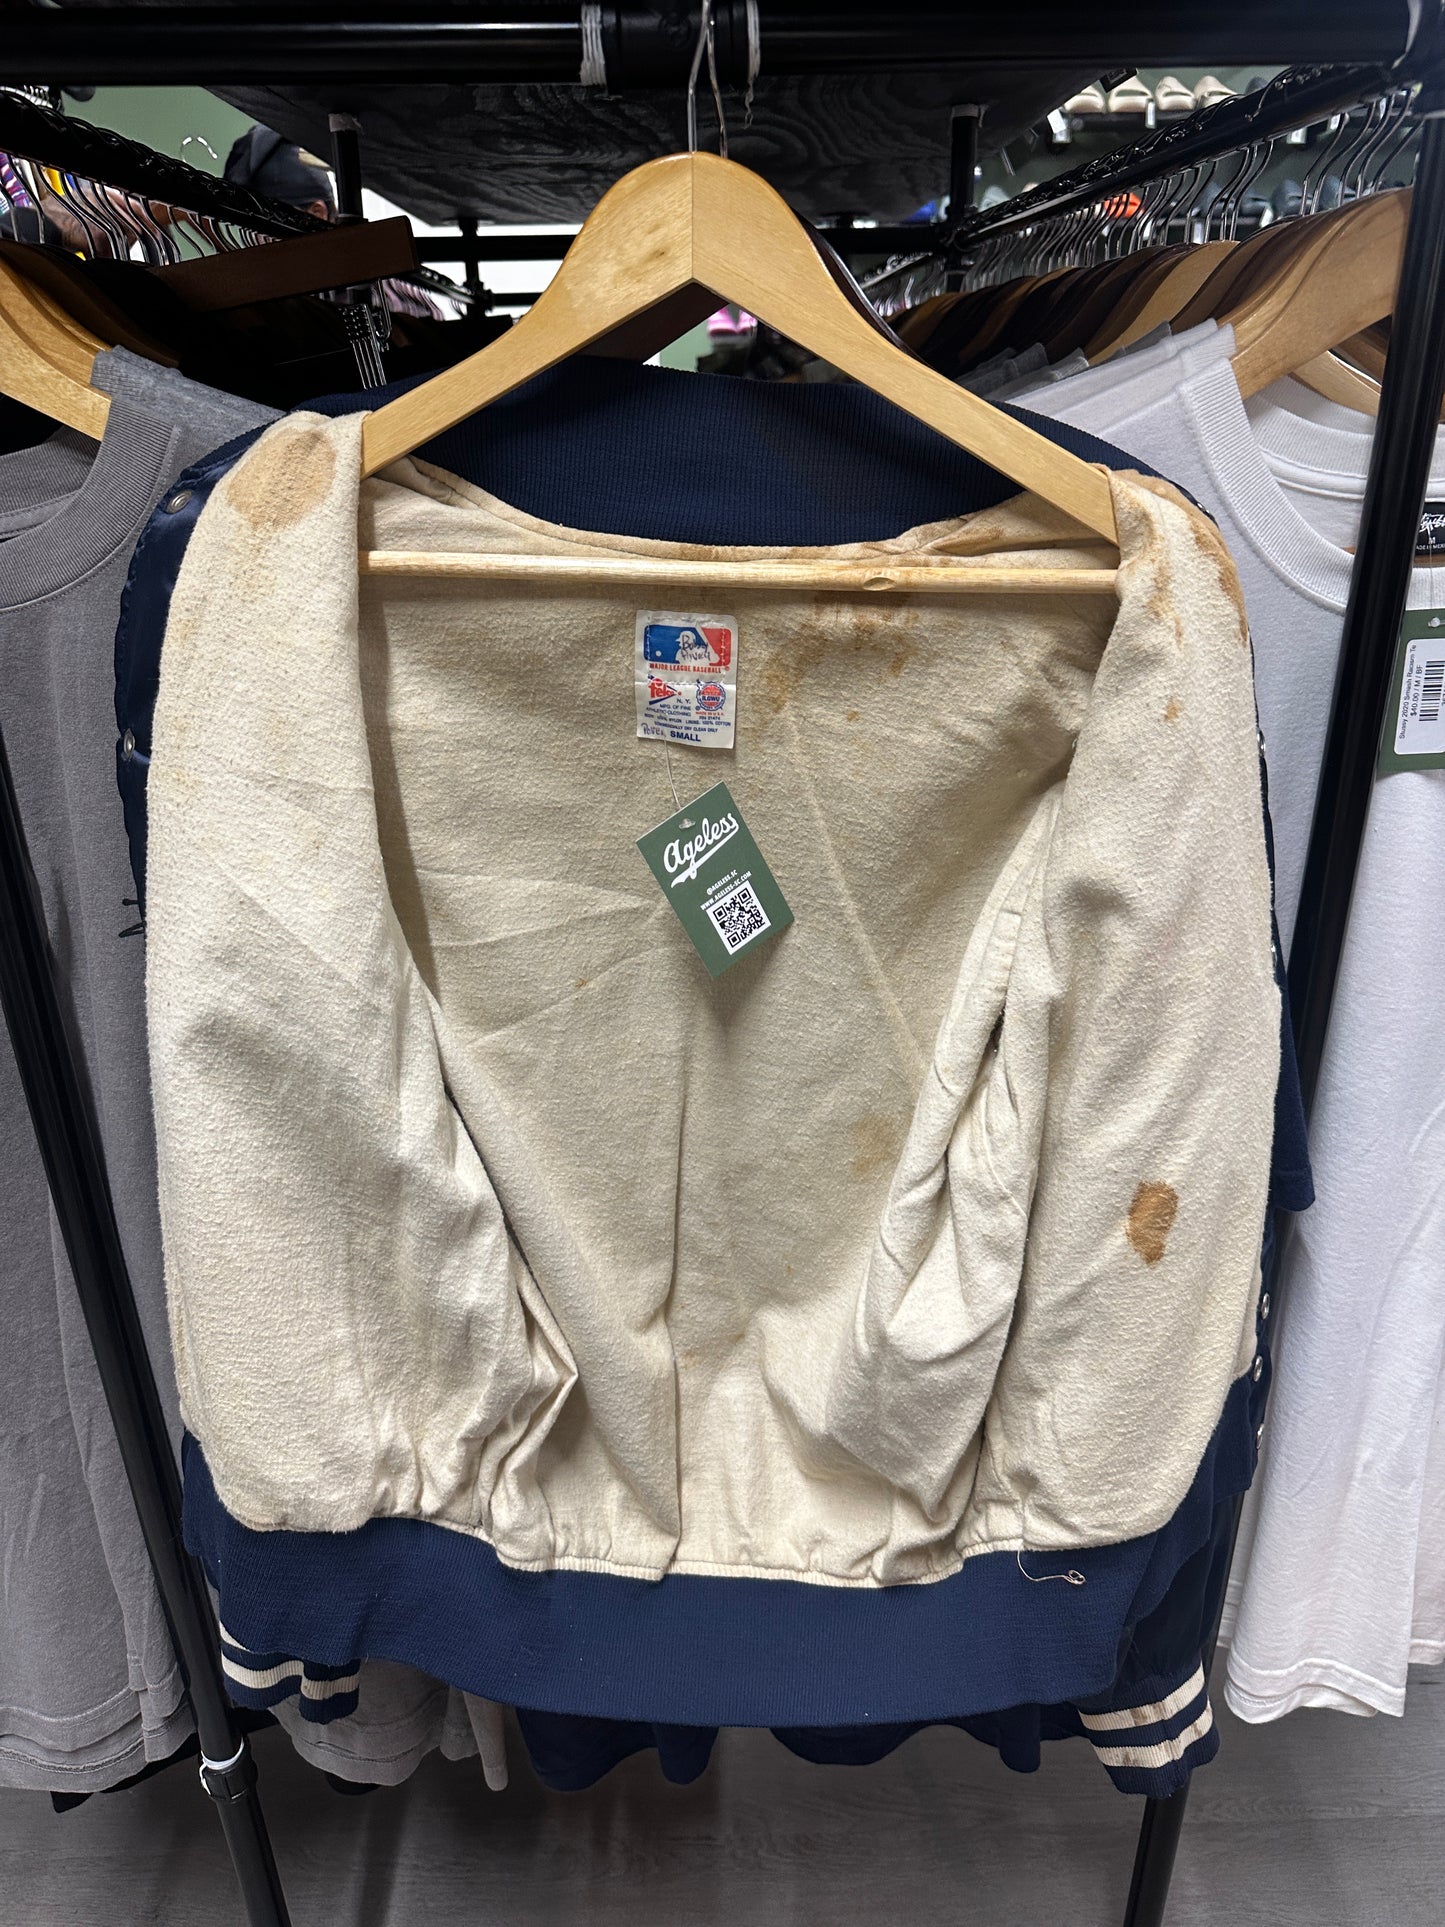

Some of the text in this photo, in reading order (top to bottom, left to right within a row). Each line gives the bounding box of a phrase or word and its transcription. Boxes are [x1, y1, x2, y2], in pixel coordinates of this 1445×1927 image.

[649, 663, 668, 671] MAJOR
[670, 664, 691, 672] LEAGUE
[1410, 692, 1419, 716] $40.00
[670, 731, 701, 742] SMALL
[663, 812, 739, 881] Ageless
